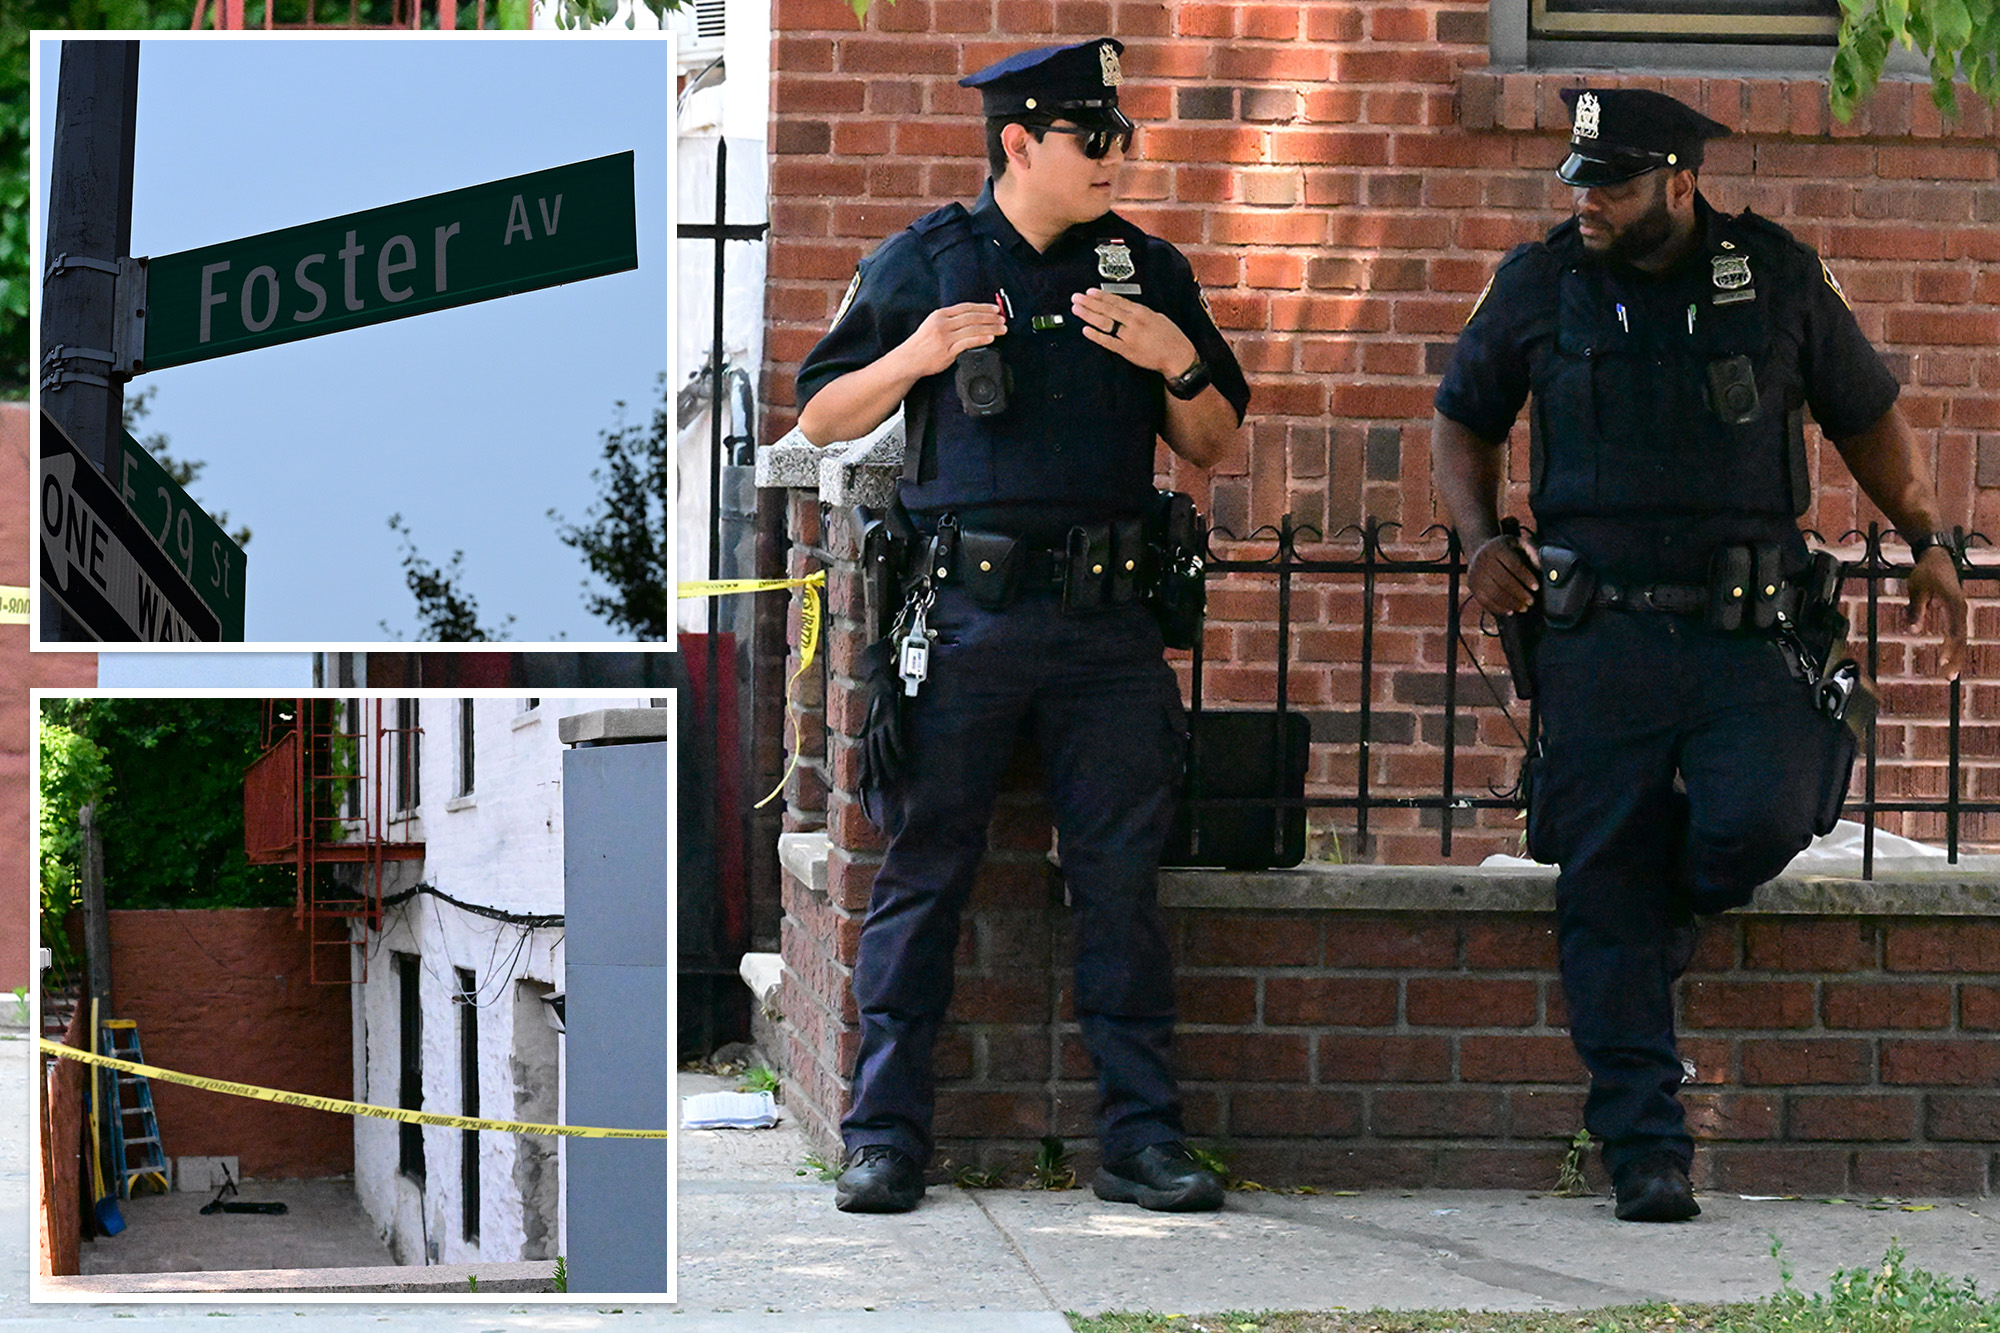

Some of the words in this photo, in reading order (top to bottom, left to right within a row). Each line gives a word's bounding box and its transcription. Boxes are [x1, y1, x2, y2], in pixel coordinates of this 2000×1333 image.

[200, 221, 461, 343] Foster
[504, 193, 563, 246] Av
[42, 473, 108, 592] ONE
[122, 450, 138, 506] E
[211, 540, 230, 599] St
